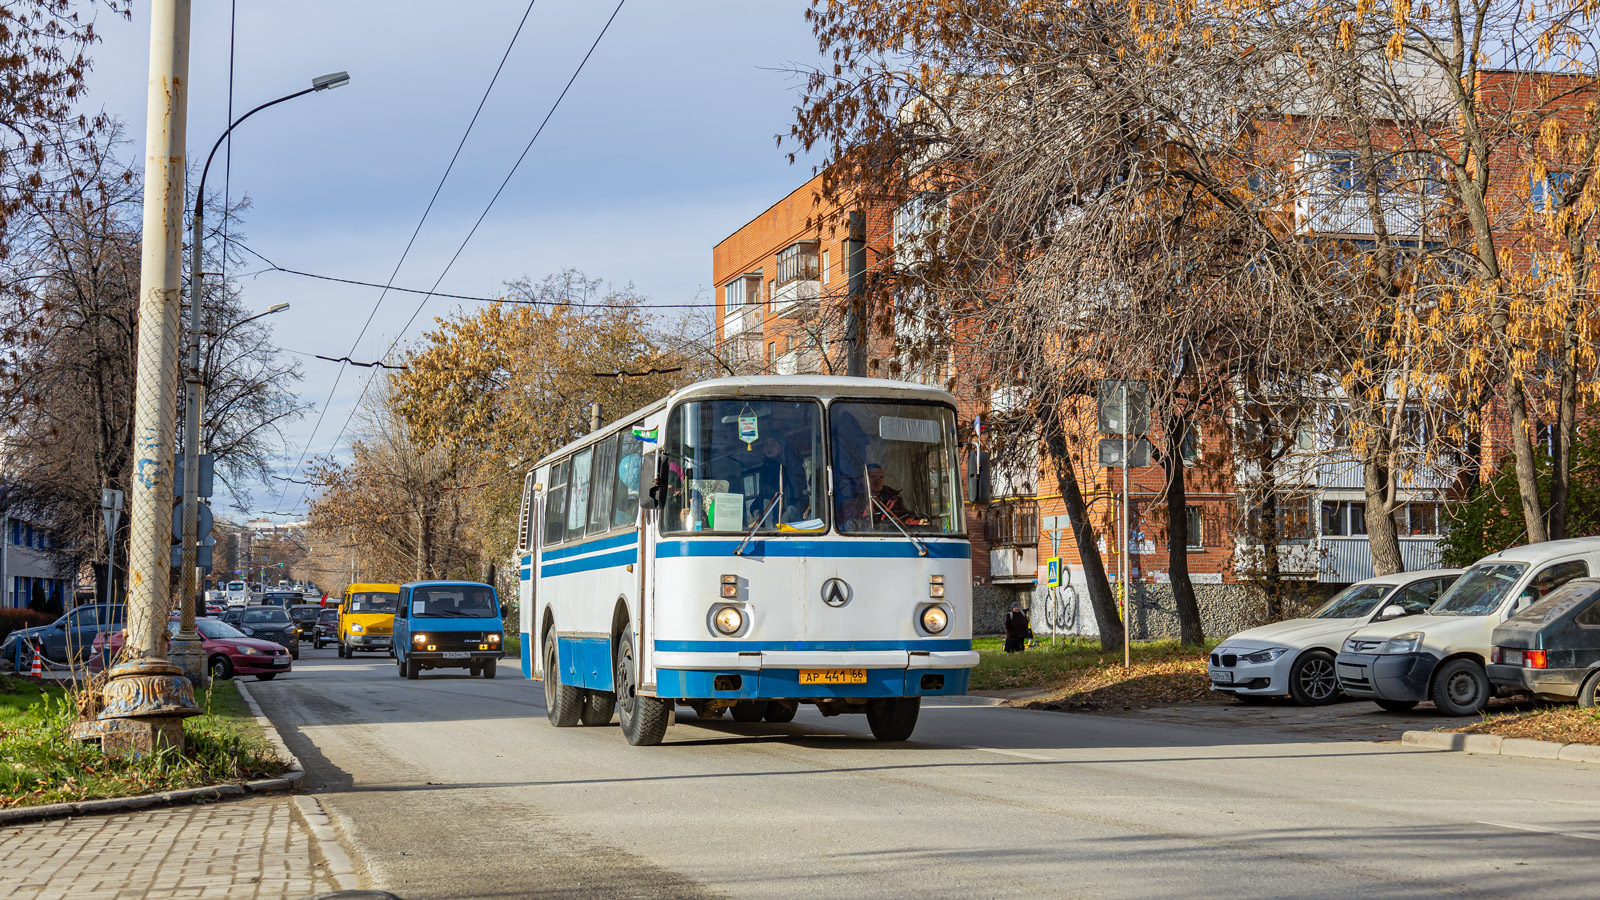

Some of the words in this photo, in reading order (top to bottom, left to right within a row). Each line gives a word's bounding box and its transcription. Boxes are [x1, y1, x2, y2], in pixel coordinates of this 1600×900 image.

[806, 673, 820, 682] АР
[825, 670, 846, 682] 441
[852, 669, 863, 678] 66
